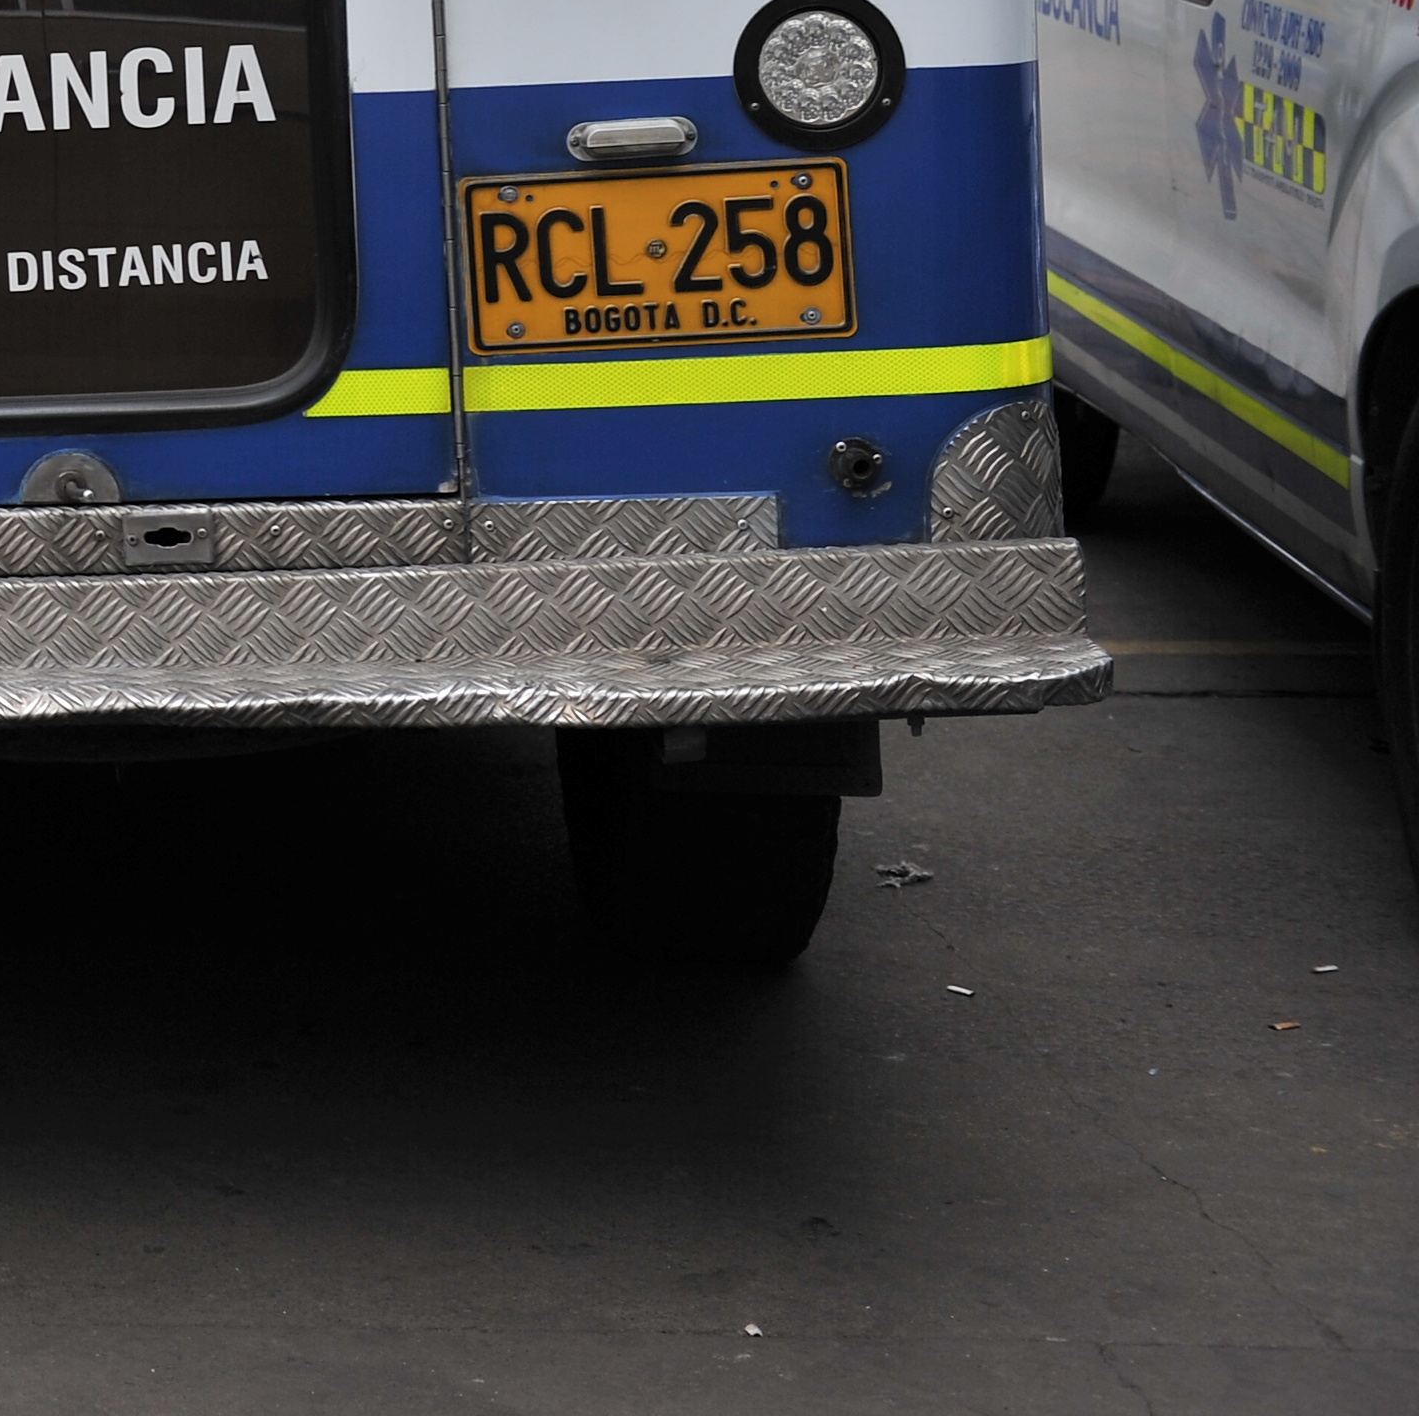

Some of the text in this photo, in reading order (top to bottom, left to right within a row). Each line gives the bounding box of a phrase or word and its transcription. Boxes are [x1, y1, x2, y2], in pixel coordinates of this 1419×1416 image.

[8, 239, 269, 292] DISTANCIA
[564, 298, 758, 335] BOGOTA D.C.
